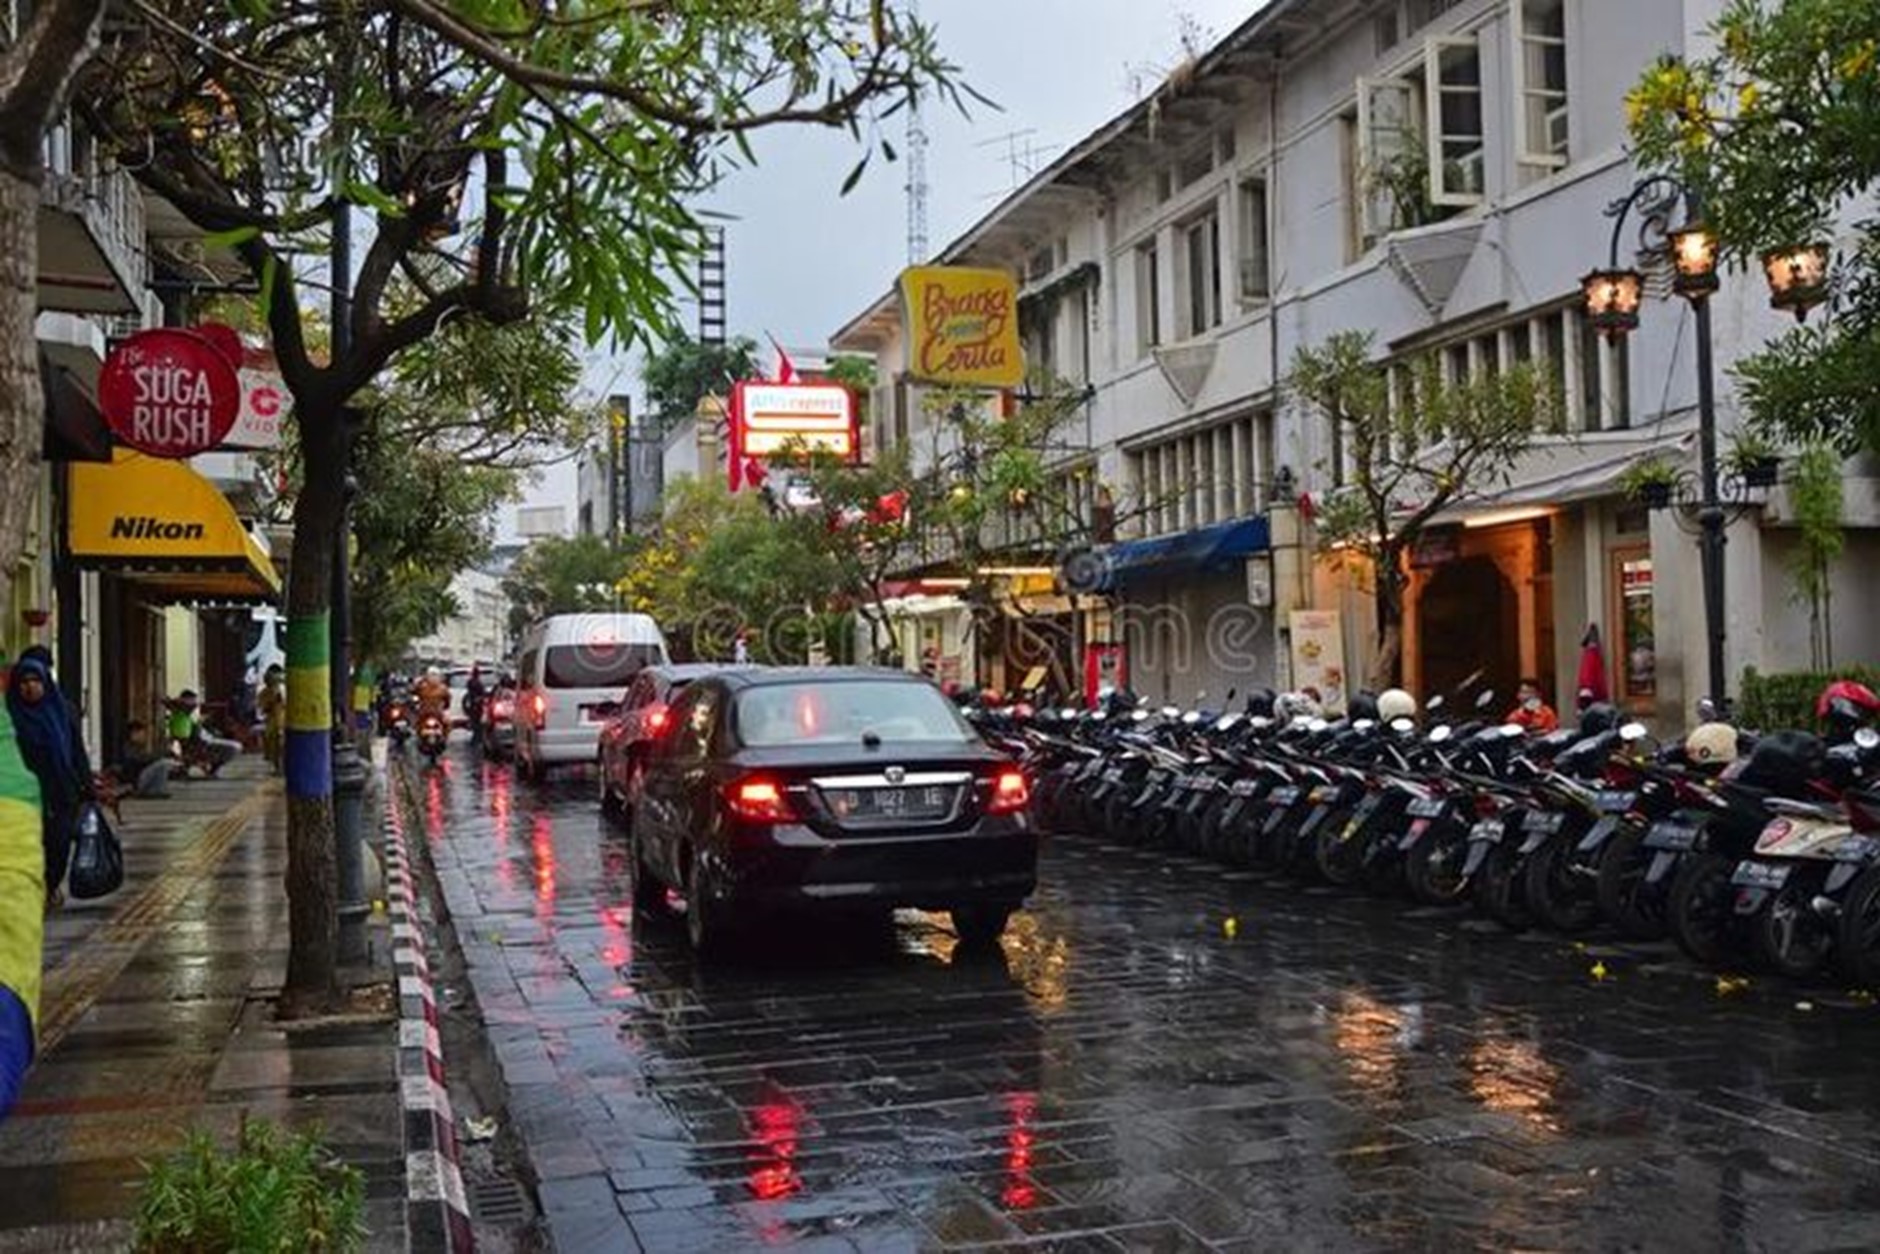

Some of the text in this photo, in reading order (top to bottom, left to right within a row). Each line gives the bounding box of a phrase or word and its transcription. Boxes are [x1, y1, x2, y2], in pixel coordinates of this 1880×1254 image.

[920, 335, 1006, 375] Cerita
[133, 366, 214, 406] SUGA
[132, 405, 211, 446] RUSH
[110, 516, 204, 540] Nikon
